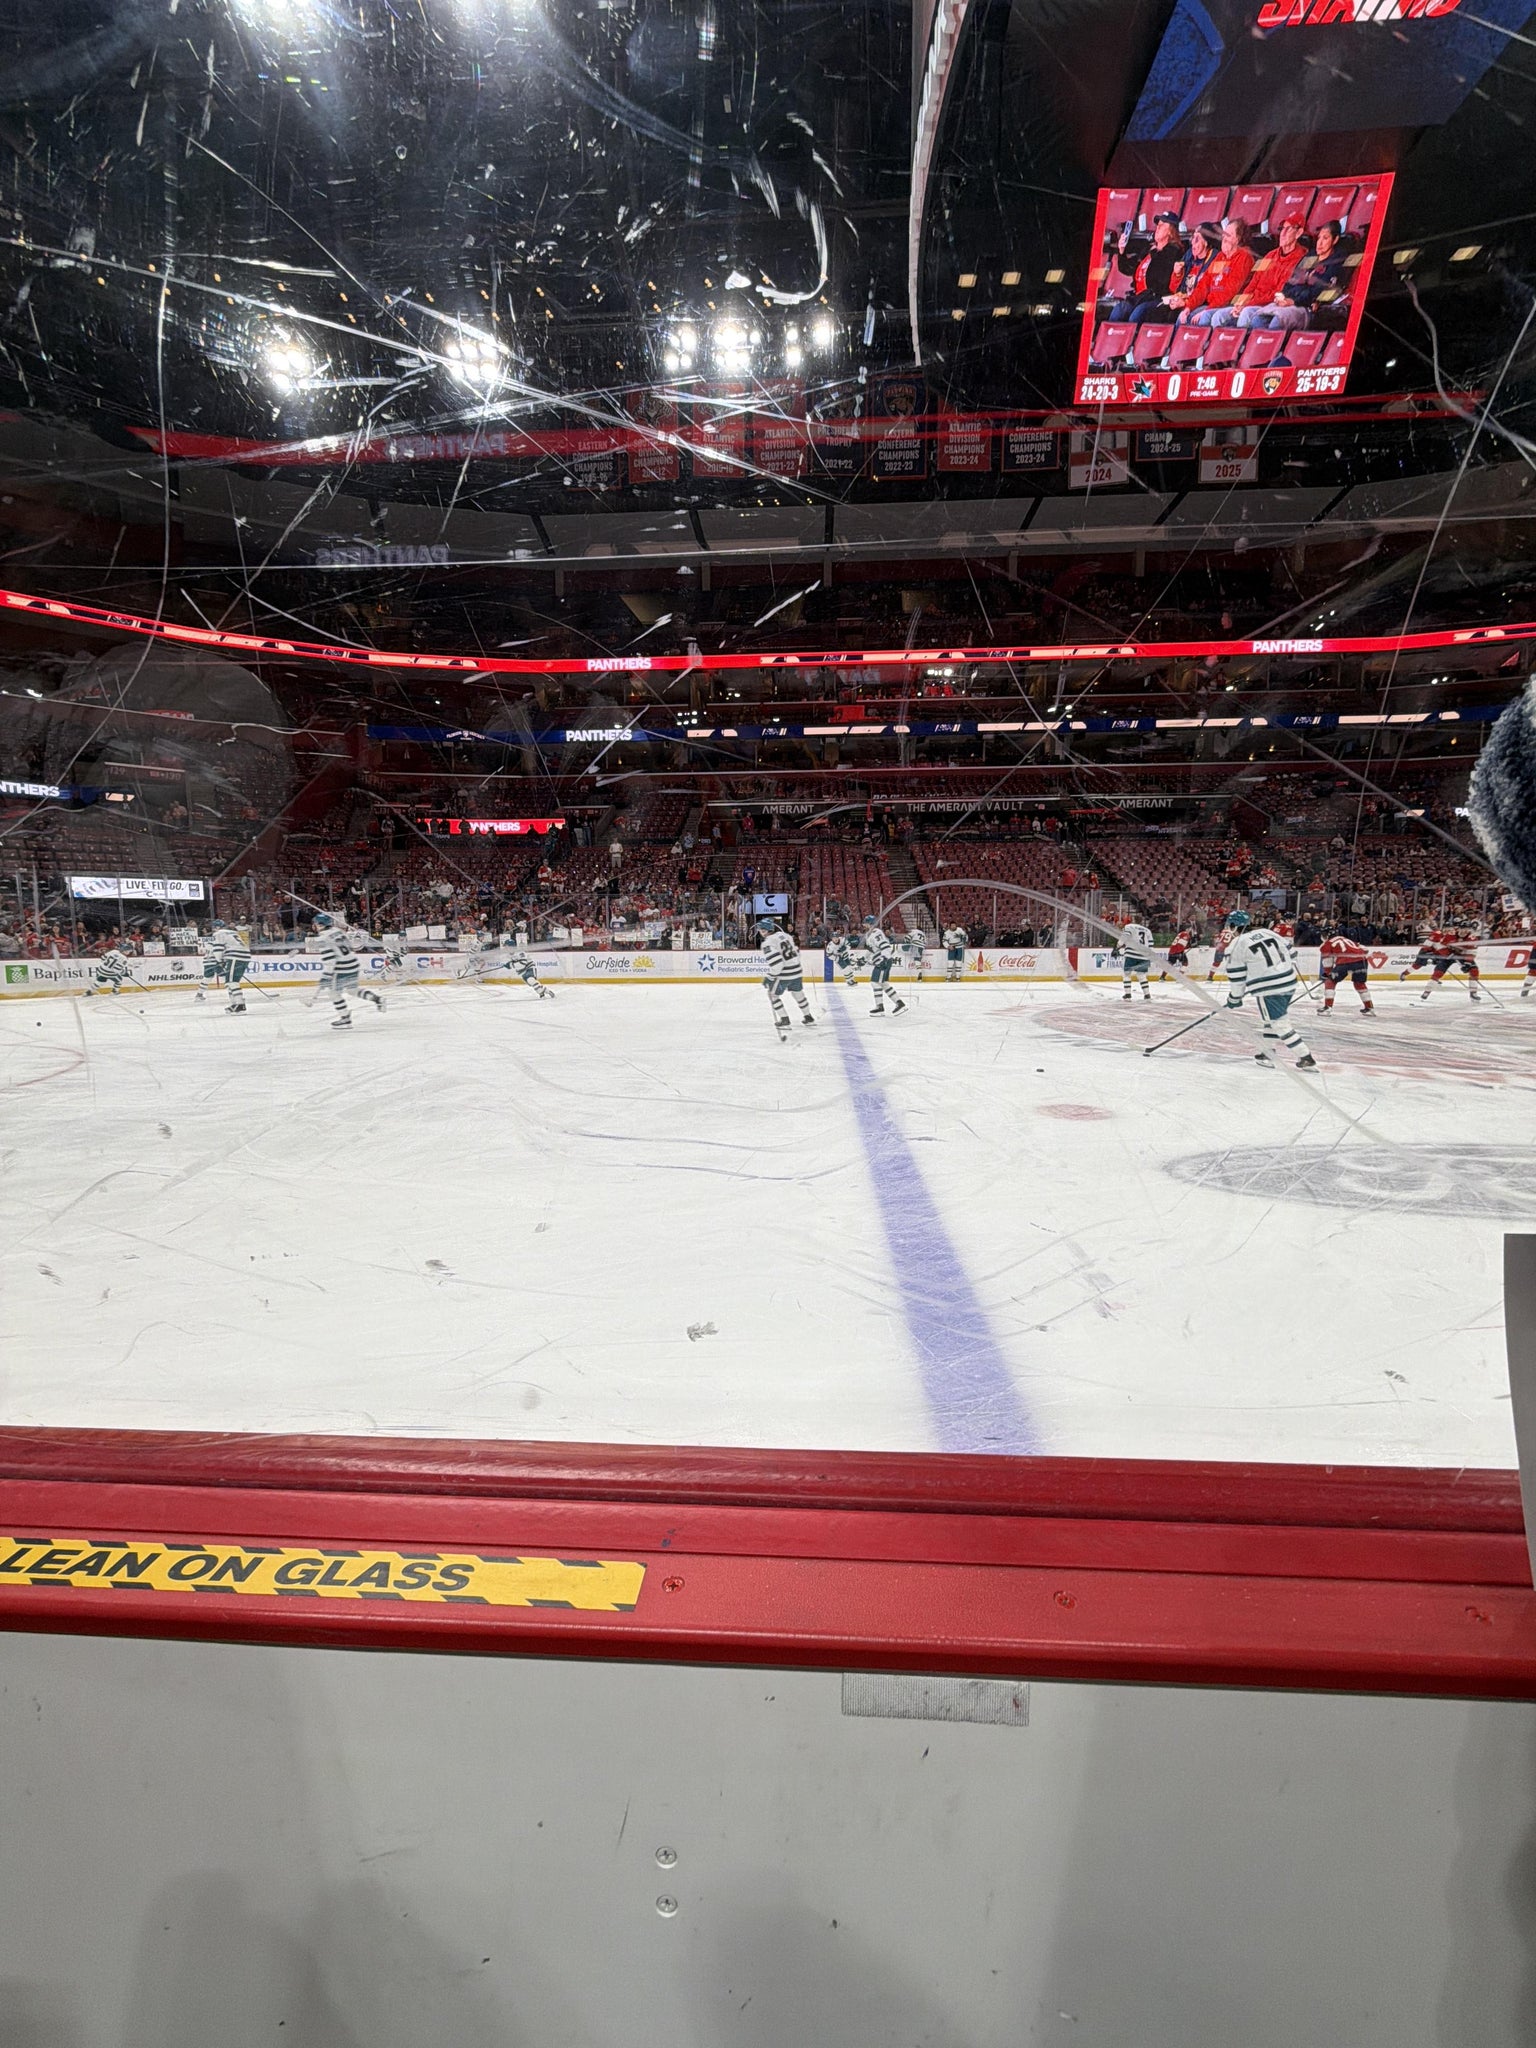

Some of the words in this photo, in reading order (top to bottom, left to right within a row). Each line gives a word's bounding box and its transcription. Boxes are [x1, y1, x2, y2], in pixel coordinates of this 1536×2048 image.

[1297, 366, 1346, 377] PANTHERS
[1083, 377, 1116, 385] SHARKS
[1230, 371, 1245, 398] 0
[1167, 374, 1181, 401] 0
[1189, 389, 1219, 397] PRE-GAME
[884, 428, 915, 438] EASTERN
[948, 422, 982, 433] ATLANTIC
[702, 434, 735, 443] ATLANTIC
[764, 429, 796, 438] ATLANTIC
[949, 433, 980, 443] DIVISION
[1008, 431, 1054, 442] CONFERENCE
[577, 440, 608, 451] EASTERN
[765, 439, 796, 449] DIVISION
[825, 436, 852, 447] TROPHY
[878, 439, 921, 449] CONFERENCE
[944, 444, 985, 454] CHAMPIONS
[1009, 442, 1052, 453] CHAMPIONS
[1150, 443, 1182, 453] 2024-25
[760, 450, 800, 460] CHAMPIONS
[878, 450, 920, 460] CHAMPIONS
[950, 455, 979, 465] 2023-24
[1015, 453, 1046, 464] 2023-24
[633, 456, 674, 466] CHAMPIONS
[767, 461, 795, 471] 2021-22
[884, 461, 914, 471] 2022-23
[574, 462, 614, 472] CHAMPIONS
[1215, 464, 1242, 478] 2025
[1085, 468, 1113, 483] 2024
[1252, 639, 1323, 653] PANTHERS
[587, 657, 652, 671] PANTHERS
[565, 728, 633, 742] PANTHERS
[0, 780, 60, 797] NTHERS
[907, 803, 926, 812] THE
[929, 802, 981, 812] AMERANT
[986, 801, 1024, 811] VAULT
[1119, 799, 1174, 808] AMERANT
[762, 804, 815, 815] AMERANT
[126, 880, 150, 890] LIVE.
[170, 881, 184, 891] GO.
[1138, 931, 1145, 945] 3
[1248, 938, 1286, 968] 77
[586, 955, 631, 970] Surfside
[717, 955, 753, 964] Broward
[262, 961, 324, 971] HOND
[33, 967, 84, 981] Baptist
[147, 973, 204, 981] NHLSHOP.co
[0, 1547, 162, 1578] LEAN
[168, 1553, 265, 1583] ON
[274, 1557, 475, 1592] GLASS
